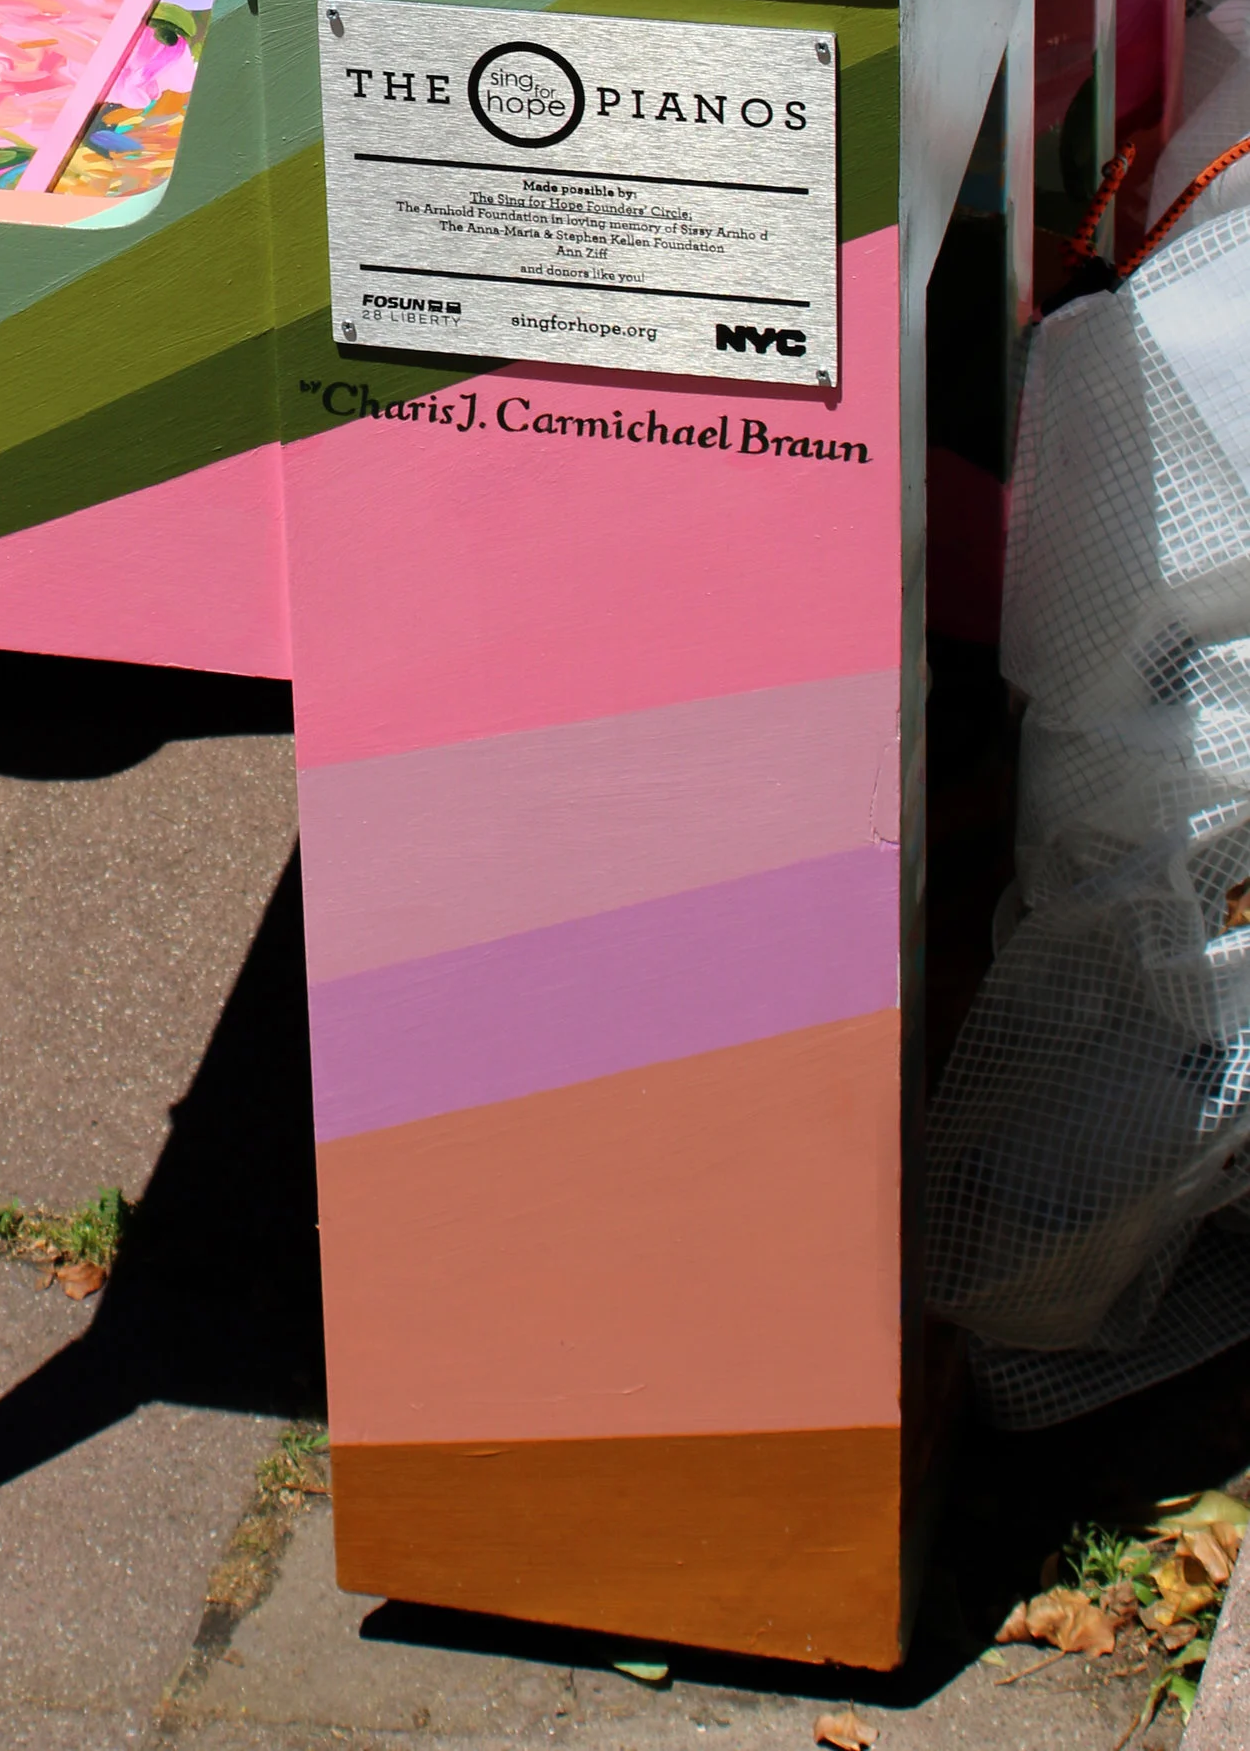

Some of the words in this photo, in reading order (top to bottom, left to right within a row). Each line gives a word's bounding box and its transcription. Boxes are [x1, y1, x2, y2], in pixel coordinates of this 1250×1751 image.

[490, 68, 533, 92] sing
[534, 84, 557, 99] for
[345, 68, 451, 105] THE
[596, 86, 808, 132] PIANOS
[486, 89, 566, 120] hope
[469, 191, 494, 204] The
[497, 194, 525, 208] Sing
[528, 195, 547, 208] for
[549, 198, 583, 211] Hope
[522, 179, 558, 192] Made
[561, 184, 615, 197] possible
[396, 200, 421, 213] The
[423, 203, 474, 218] Arnhold
[477, 208, 548, 224] Foundation
[551, 213, 564, 224] in
[567, 214, 606, 230] loving
[609, 220, 661, 234] memory
[664, 222, 677, 233] of
[680, 224, 713, 238] Sissy
[715, 227, 769, 242] Arnhod
[439, 220, 464, 232] The
[466, 222, 540, 238] Anna-Maria
[543, 229, 554, 239] &
[556, 231, 607, 244] Stephen
[609, 234, 651, 247] Kellen
[654, 238, 725, 253] Foundation
[555, 245, 583, 258] Ann
[586, 248, 609, 260] Ziff
[520, 263, 543, 275] and
[546, 266, 589, 279] donors
[592, 268, 616, 281] like
[362, 294, 425, 312] FOSUN
[362, 309, 383, 321] 28
[390, 311, 462, 328] LIBERTY
[511, 314, 658, 341] singforhope.org
[715, 323, 807, 357] NYC
[321, 381, 455, 425] Charis
[456, 392, 487, 432] J.
[496, 396, 733, 450] Carmichael
[736, 417, 874, 465] Braun
